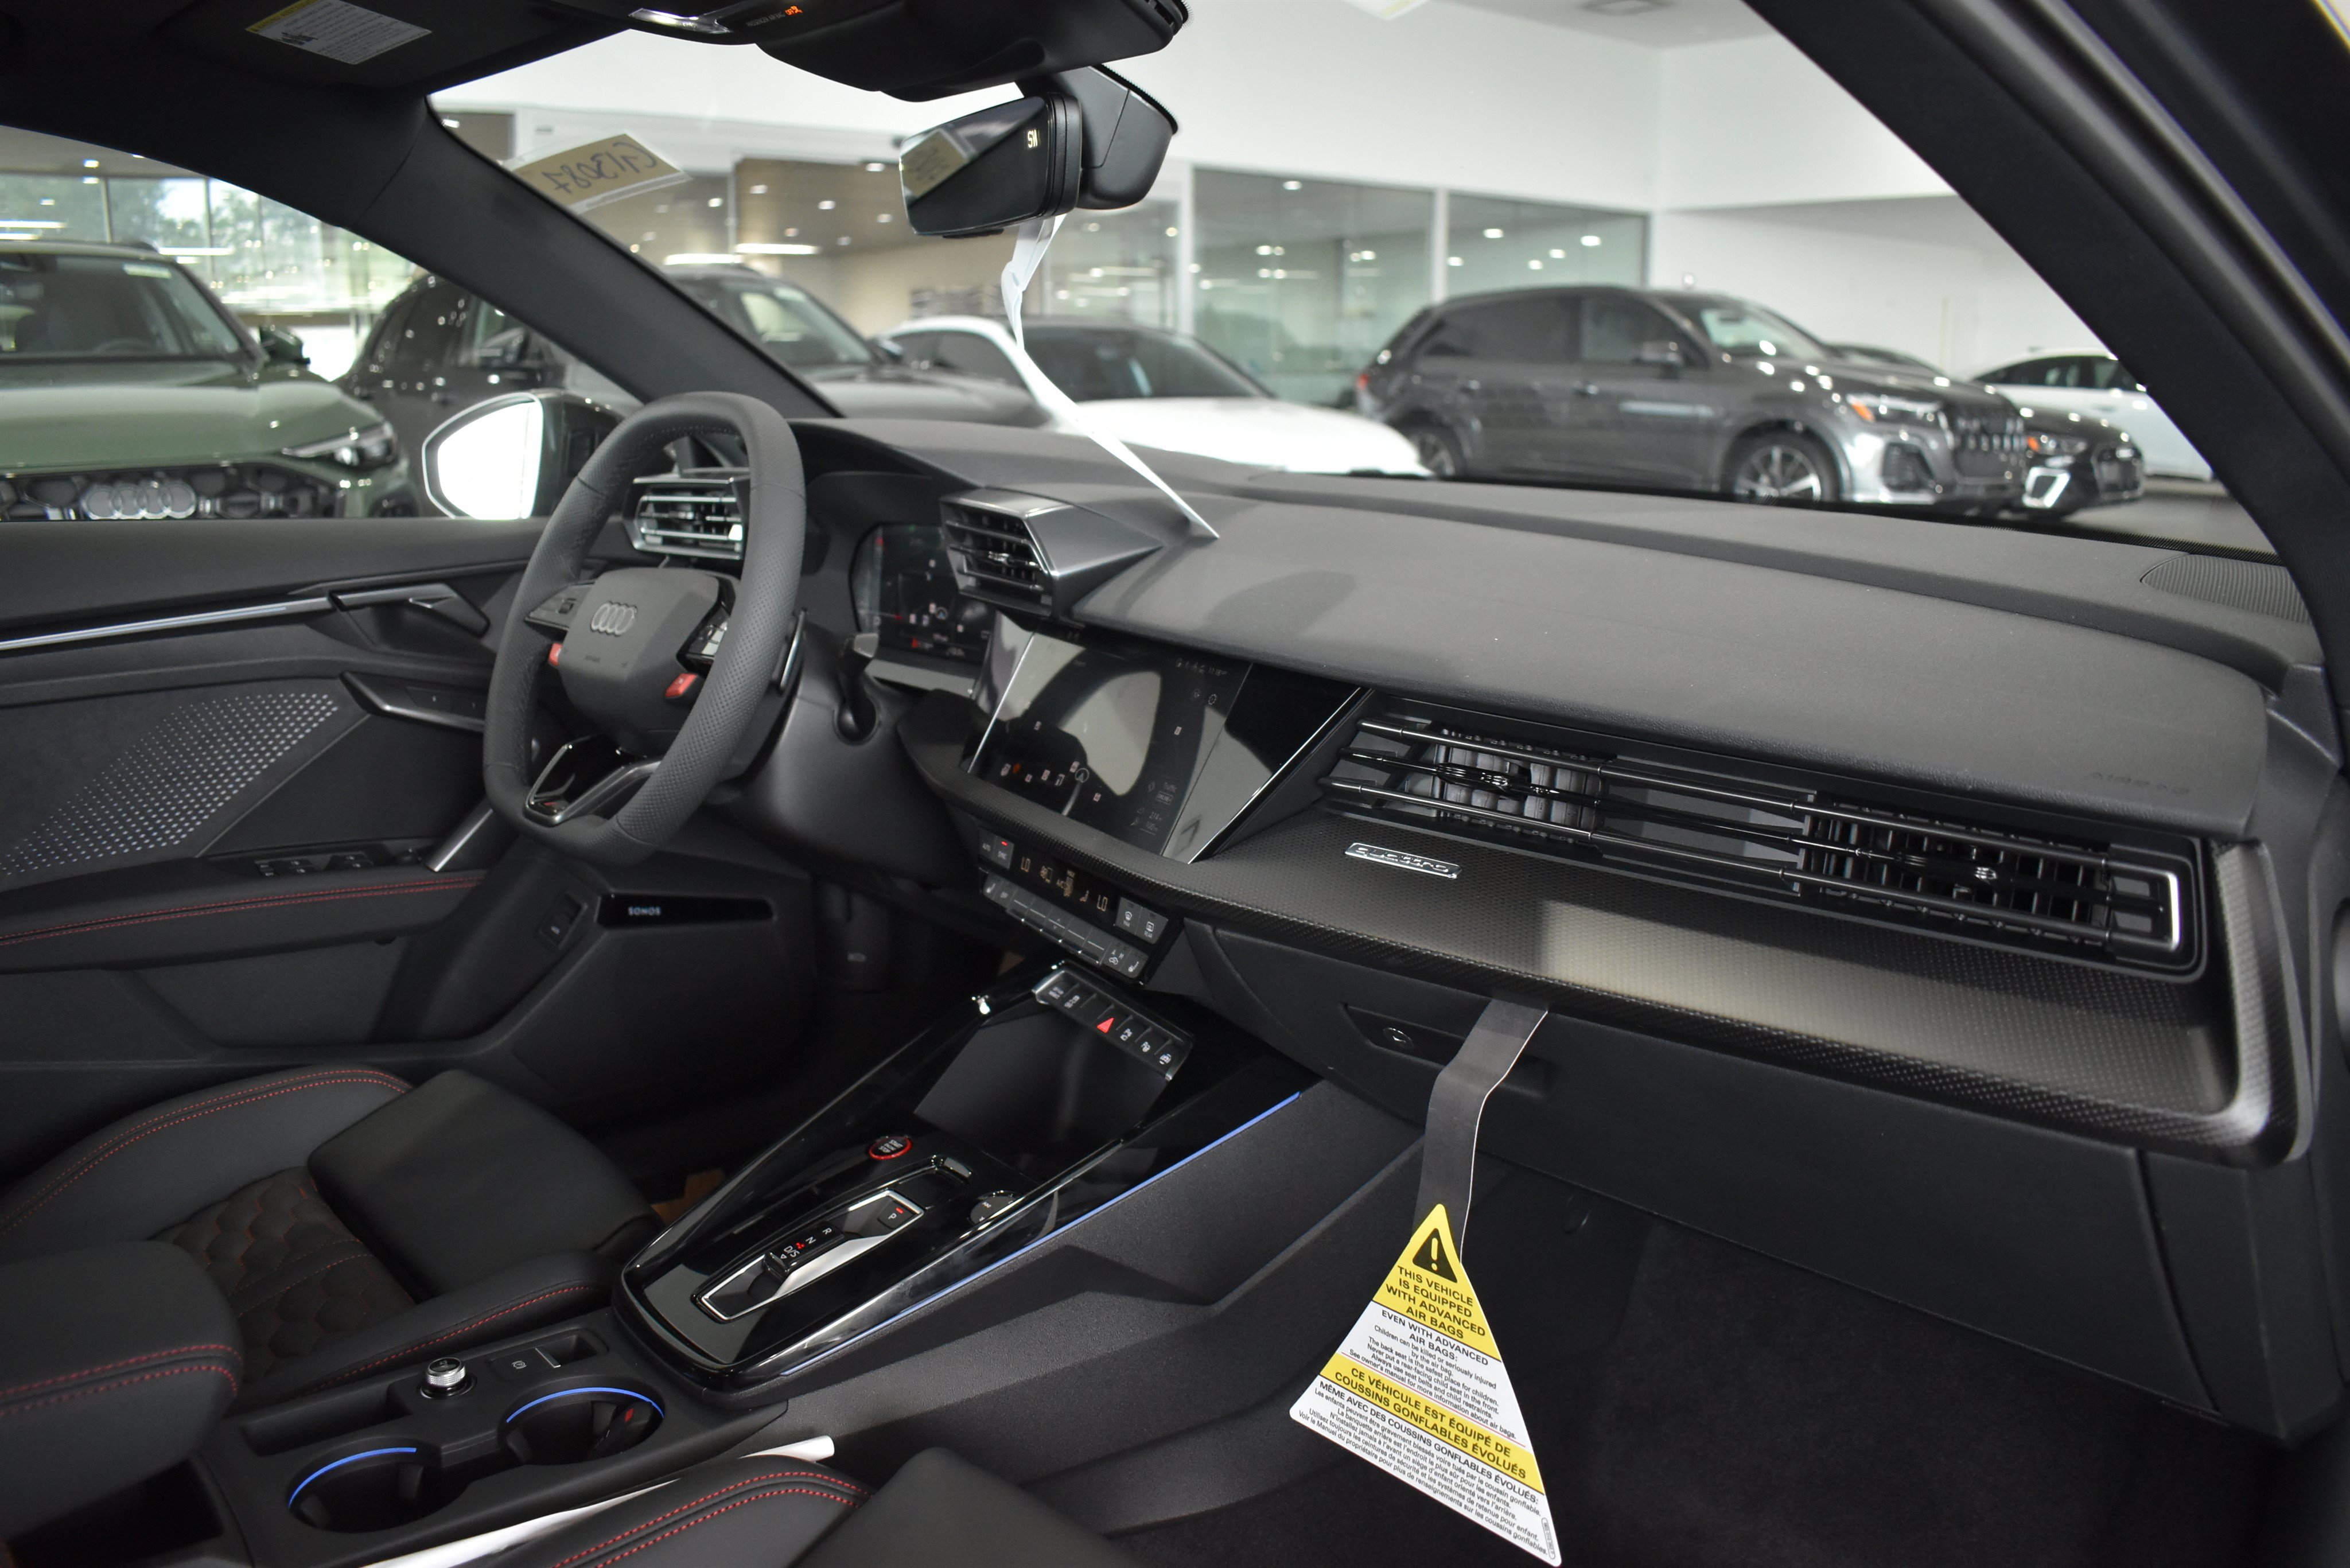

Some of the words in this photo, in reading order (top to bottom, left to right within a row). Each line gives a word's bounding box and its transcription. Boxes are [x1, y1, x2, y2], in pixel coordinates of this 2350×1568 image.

[1355, 847, 1449, 873] quattro
[627, 905, 662, 917] SONOS
[806, 1236, 816, 1244] N
[822, 1227, 832, 1235] R
[888, 1212, 897, 1220] P
[784, 1245, 800, 1258] D/S
[1386, 1283, 1416, 1305] WITH
[1419, 1299, 1485, 1336] ADVANCED
[1398, 1264, 1423, 1283] THIS
[1426, 1277, 1473, 1307] VEHICLE
[1399, 1277, 1410, 1290] IS
[1413, 1284, 1472, 1318] EQUIPPED
[1382, 1309, 1406, 1326] EVEN
[1408, 1321, 1433, 1340] WITH
[1434, 1336, 1488, 1365] ADVANCED
[1406, 1306, 1426, 1322] AIR
[1430, 1316, 1464, 1339] BAGS
[1409, 1333, 1425, 1346] AIR
[1428, 1341, 1457, 1362] BAGS:
[1367, 1343, 1384, 1357] Never
[1385, 1353, 1395, 1363] put
[1400, 1361, 1433, 1382] rear-facing
[1433, 1378, 1449, 1389] child
[1449, 1386, 1462, 1396] seat
[1463, 1391, 1470, 1400] in
[1470, 1395, 1481, 1406] the
[1482, 1400, 1499, 1415] front.
[1368, 1336, 1379, 1347] The
[1380, 1341, 1394, 1354] back
[1394, 1350, 1407, 1361] seat
[1408, 1356, 1413, 1364] is
[1414, 1359, 1425, 1369] the
[1425, 1365, 1443, 1379] safest
[1444, 1375, 1461, 1387] place
[1461, 1383, 1471, 1392] for
[1472, 1388, 1499, 1406] children.
[1371, 1353, 1392, 1368] Always
[1392, 1364, 1403, 1374] use
[1404, 1371, 1417, 1381] seat
[1418, 1376, 1433, 1389] belts
[1433, 1385, 1445, 1395] and
[1446, 1391, 1461, 1403] child
[1462, 1399, 1493, 1419] restraints.
[1374, 1324, 1398, 1341] Children
[1399, 1338, 1410, 1347] can
[1411, 1342, 1419, 1352] be
[1420, 1347, 1436, 1360] killed
[1445, 1360, 1473, 1379] seriously
[1474, 1373, 1496, 1390] injured
[1411, 1349, 1419, 1361] by
[1419, 1355, 1430, 1364] the
[1430, 1361, 1439, 1369] air
[1440, 1364, 1453, 1377] bag.
[1349, 1348, 1360, 1359] See
[1384, 1368, 1406, 1383] manual
[1407, 1378, 1416, 1388] for
[1417, 1384, 1433, 1396] more
[1434, 1392, 1469, 1415] information
[1470, 1411, 1489, 1425] about
[1489, 1421, 1499, 1429] air
[1500, 1425, 1516, 1439] bags.
[1351, 1367, 1365, 1382] CE
[1368, 1375, 1421, 1411] VÉHICULE
[1424, 1404, 1446, 1423] EST
[1448, 1417, 1491, 1448] ÉQUIPÉ
[1495, 1441, 1511, 1458] DE
[1314, 1387, 1324, 1398] Les
[1325, 1394, 1345, 1409] enfants
[1345, 1406, 1368, 1422] peuvent
[1368, 1417, 1380, 1429] être
[1380, 1425, 1412, 1446] gravement
[1413, 1441, 1434, 1458] blessés
[1435, 1454, 1451, 1467] voire
[1452, 1462, 1465, 1475] tués
[1465, 1471, 1477, 1481] par
[1477, 1476, 1484, 1485] le
[1484, 1481, 1508, 1499] coussin
[1509, 1495, 1540, 1517] gonflable.
[1320, 1380, 1345, 1400] MÊME
[1346, 1396, 1368, 1413] AVEC
[1369, 1407, 1386, 1422] DES
[1387, 1418, 1432, 1447] COUSSINS
[1434, 1442, 1492, 1480] GONFLABLES
[1494, 1474, 1538, 1505] ÉVOLUÉS:
[1334, 1371, 1390, 1407] COUSSINS
[1393, 1402, 1468, 1449] GONFLABLES
[1471, 1442, 1526, 1479] ÉVOLUÉS
[1299, 1410, 1310, 1421] Voir
[1310, 1417, 1316, 1425] le
[1316, 1420, 1337, 1437] Manuel
[1337, 1433, 1345, 1441] du
[1345, 1437, 1378, 1460] propriétaire
[1378, 1456, 1393, 1468] pour
[1392, 1464, 1406, 1476] plus
[1406, 1472, 1415, 1480] de
[1415, 1477, 1462, 1508] renseignements
[1463, 1504, 1474, 1513] sur
[1474, 1508, 1484, 1519] les
[1484, 1516, 1512, 1535] coussins
[1512, 1532, 1546, 1554] gonflables.
[1309, 1407, 1329, 1424] Utilisez
[1329, 1419, 1352, 1437] toujours
[1352, 1432, 1361, 1442] les
[1361, 1438, 1387, 1457] ceintures
[1388, 1453, 1396, 1461] de
[1396, 1458, 1419, 1474] sécurité
[1420, 1471, 1427, 1479] et
[1427, 1473, 1437, 1484] les
[1437, 1480, 1465, 1500] systèmes
[1466, 1497, 1474, 1505] de
[1475, 1502, 1499, 1519] retenue
[1500, 1516, 1516, 1528] pour
[1516, 1525, 1539, 1542] enfant.
[1337, 1408, 1344, 1417] La
[1345, 1412, 1373, 1433] banquette
[1373, 1429, 1392, 1443] arrière
[1393, 1439, 1402, 1449] est
[1428, 1458, 1434, 1466] le
[1434, 1462, 1448, 1474] plus
[1449, 1470, 1460, 1480] sûr
[1460, 1476, 1475, 1488] pour
[1475, 1484, 1485, 1494] les
[1485, 1491, 1511, 1508] enfants.
[1358, 1427, 1377, 1443] jamais
[1403, 1453, 1411, 1462] un
[1411, 1458, 1427, 1471] siège
[1454, 1481, 1476, 1497] orienté
[1476, 1493, 1490, 1505] vers
